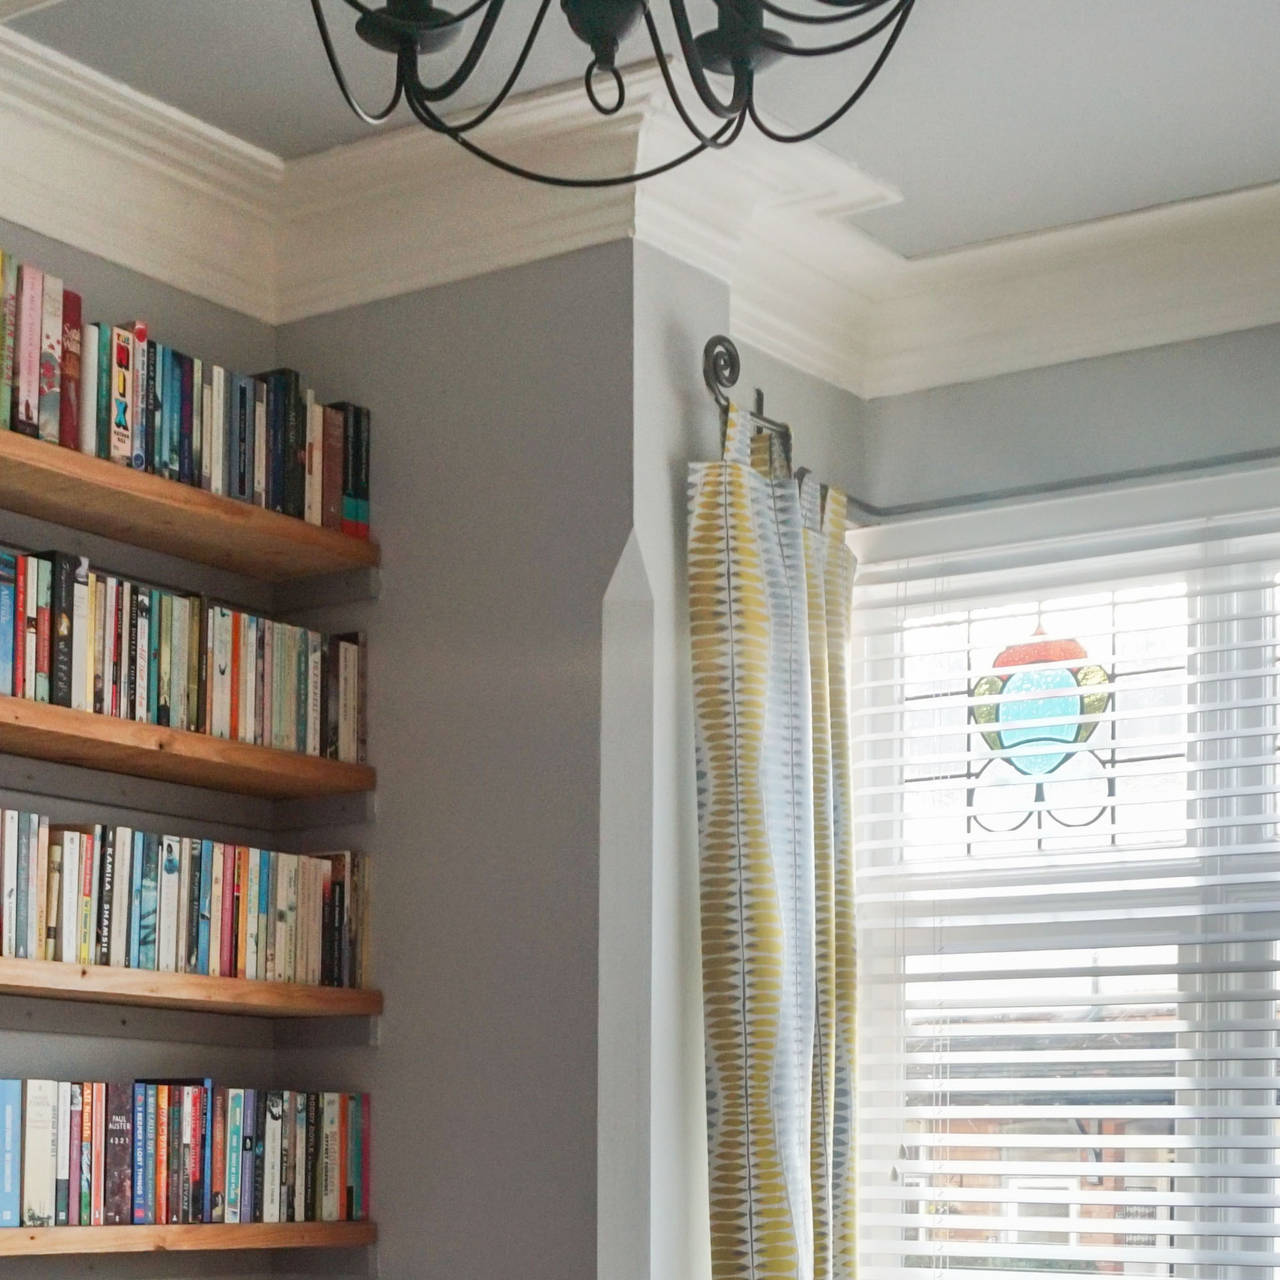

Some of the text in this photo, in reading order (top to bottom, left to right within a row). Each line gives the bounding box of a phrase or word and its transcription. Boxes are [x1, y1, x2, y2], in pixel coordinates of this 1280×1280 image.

[114, 342, 131, 431] NIX
[0, 586, 11, 624] Allende
[101, 847, 113, 953] KAMILA SHAMSIE
[83, 1105, 91, 1137] Smith
[112, 1115, 126, 1123] PAUL
